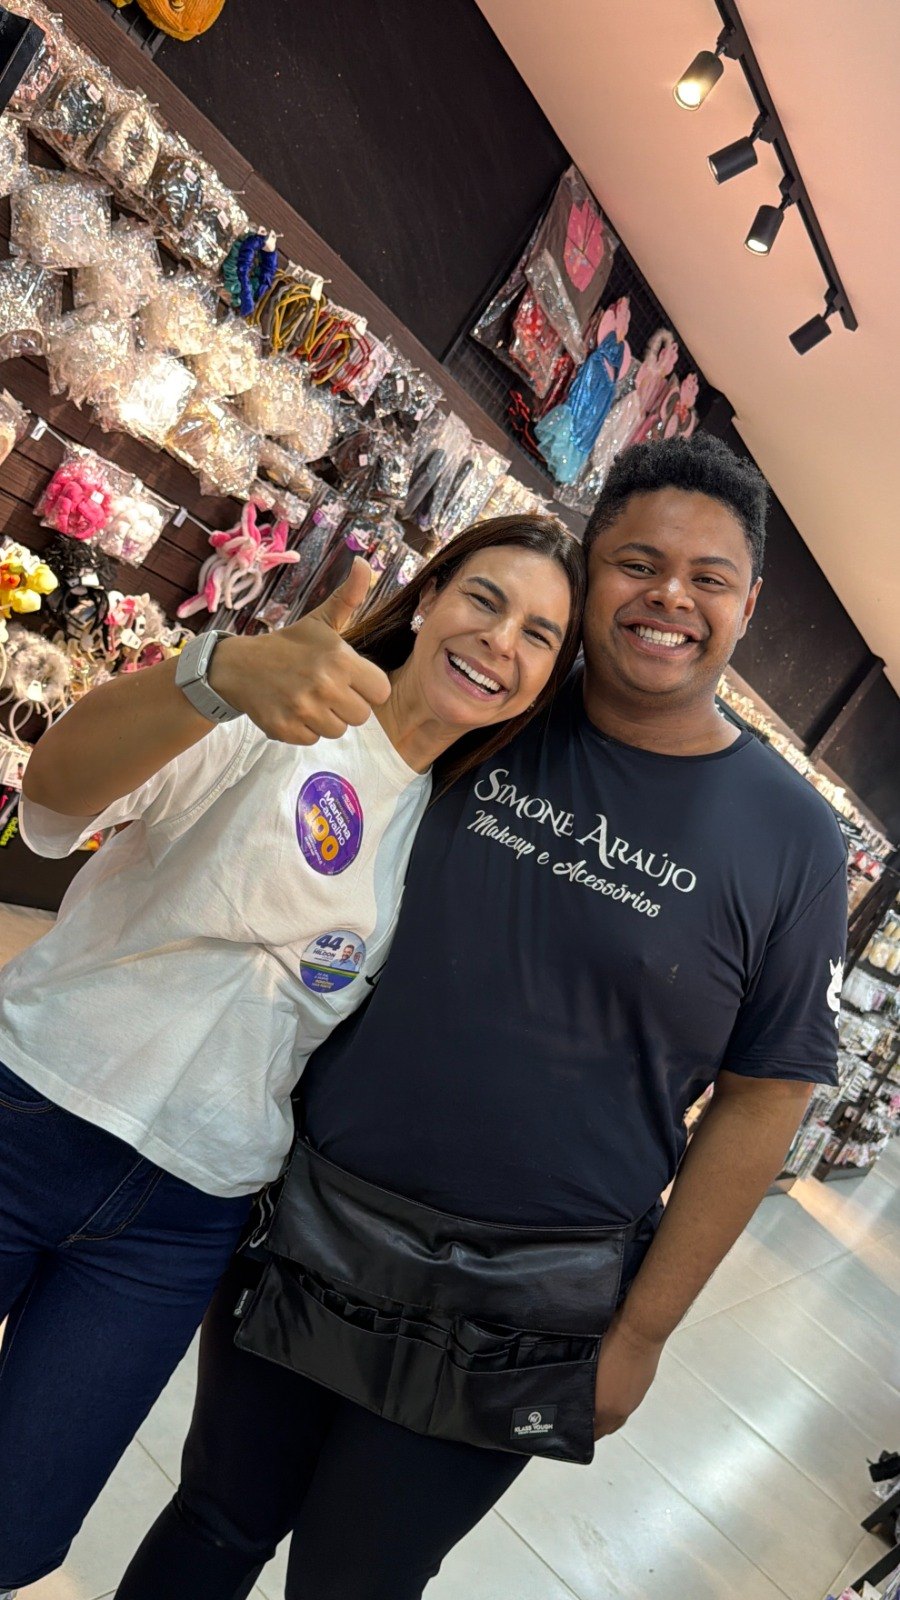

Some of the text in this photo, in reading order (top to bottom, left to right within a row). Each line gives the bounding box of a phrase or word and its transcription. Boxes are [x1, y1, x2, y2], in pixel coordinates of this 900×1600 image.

[319, 798, 346, 846] Carvalho
[324, 790, 351, 838] Mariana
[474, 768, 574, 837] SIMONE
[304, 804, 339, 861] 100
[467, 810, 661, 917] Makeup e Acessórios
[316, 935, 344, 951] 44
